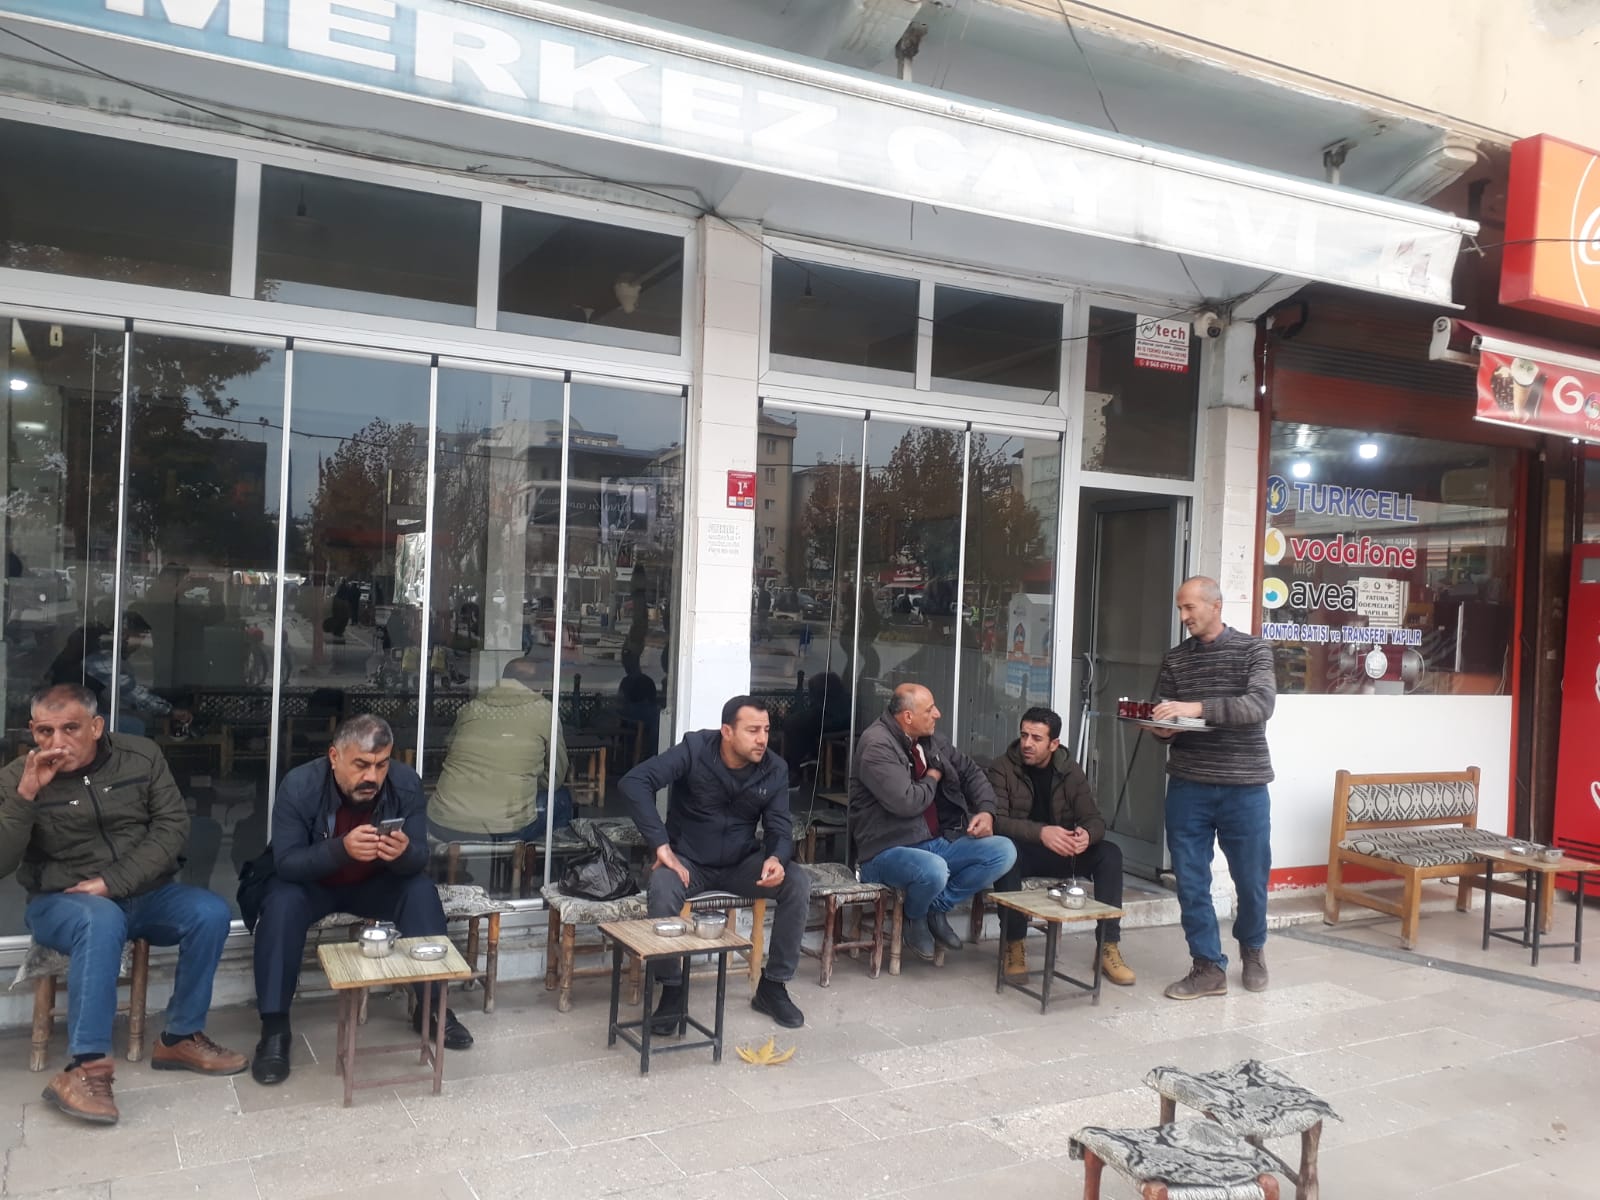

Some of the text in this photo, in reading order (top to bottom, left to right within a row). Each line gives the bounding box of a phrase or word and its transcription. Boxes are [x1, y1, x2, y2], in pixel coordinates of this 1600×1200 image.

[1294, 482, 1419, 523] TURKCELL
[1290, 534, 1417, 569] vodafone
[1290, 581, 1358, 611] avea
[1365, 594, 1389, 602] FATURA
[1301, 624, 1329, 645] SATIŞI
[1330, 630, 1341, 642] ve
[1391, 628, 1422, 646] YAPILIR
